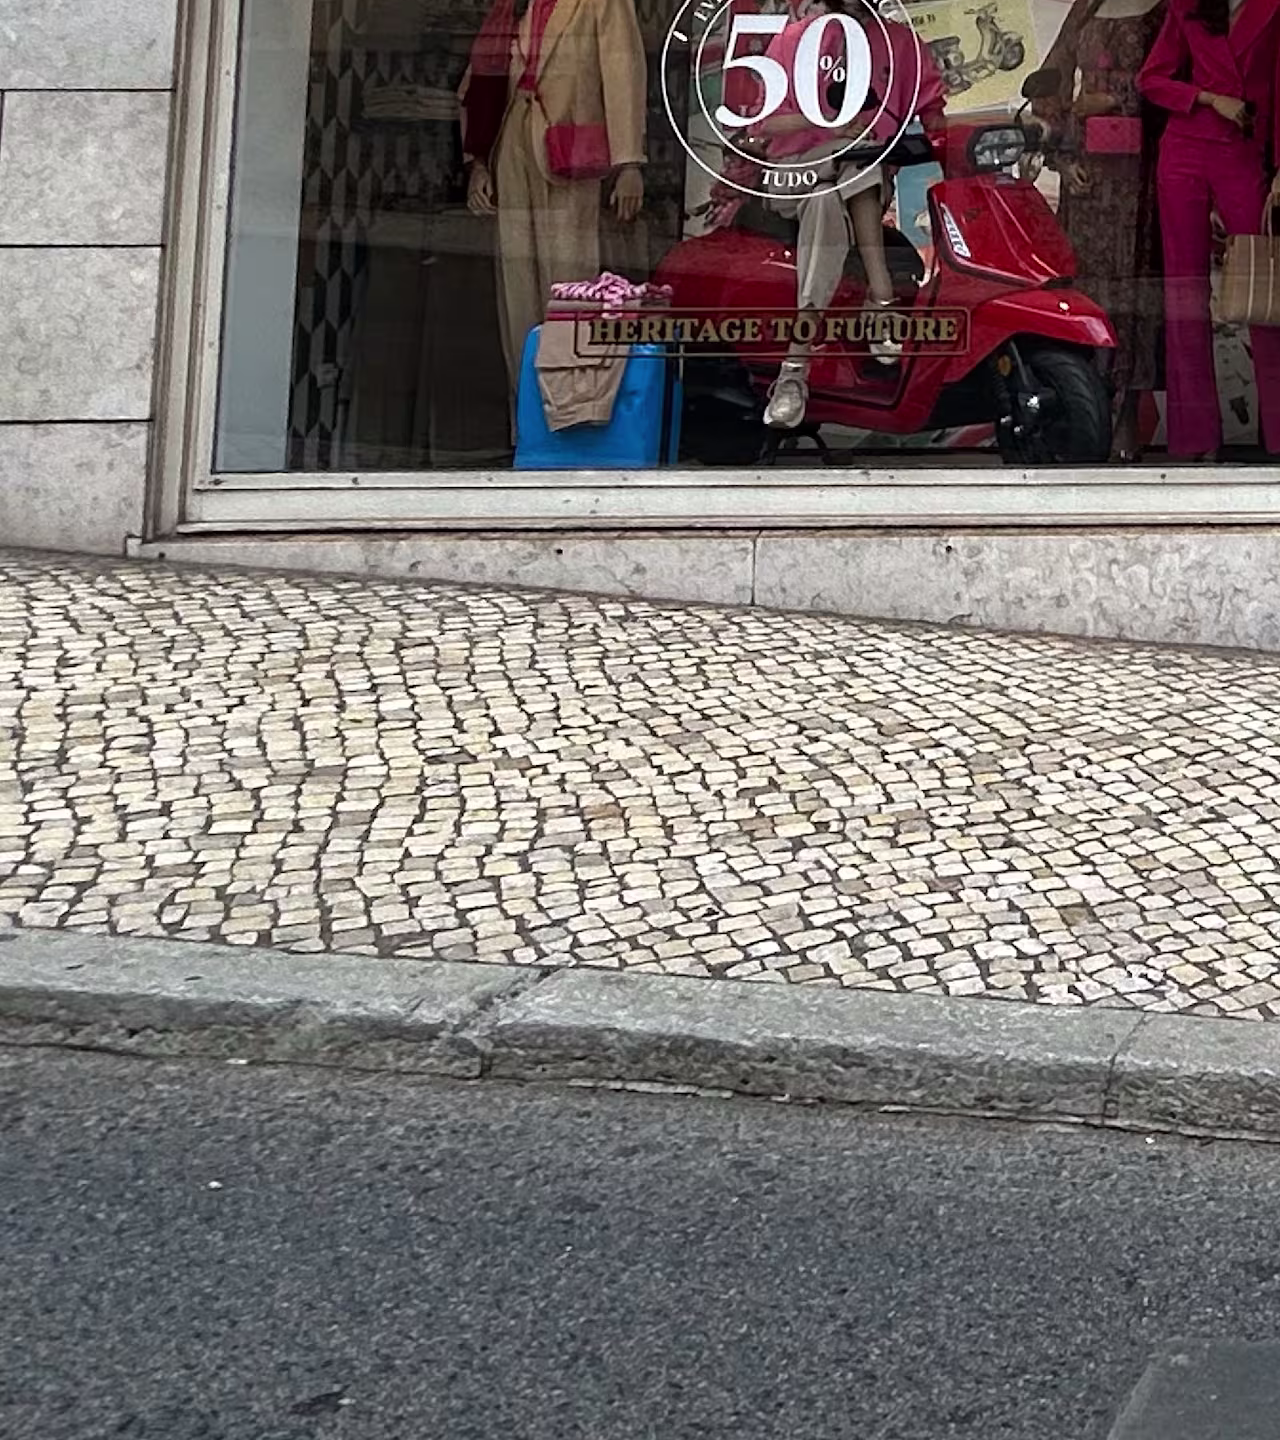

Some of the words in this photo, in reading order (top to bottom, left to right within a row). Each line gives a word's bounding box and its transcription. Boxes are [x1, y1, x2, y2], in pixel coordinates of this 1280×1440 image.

[761, 168, 818, 187] TUDO
[587, 317, 762, 344] HERITAGE
[769, 317, 817, 343] TO
[826, 317, 958, 343] FUTURE
